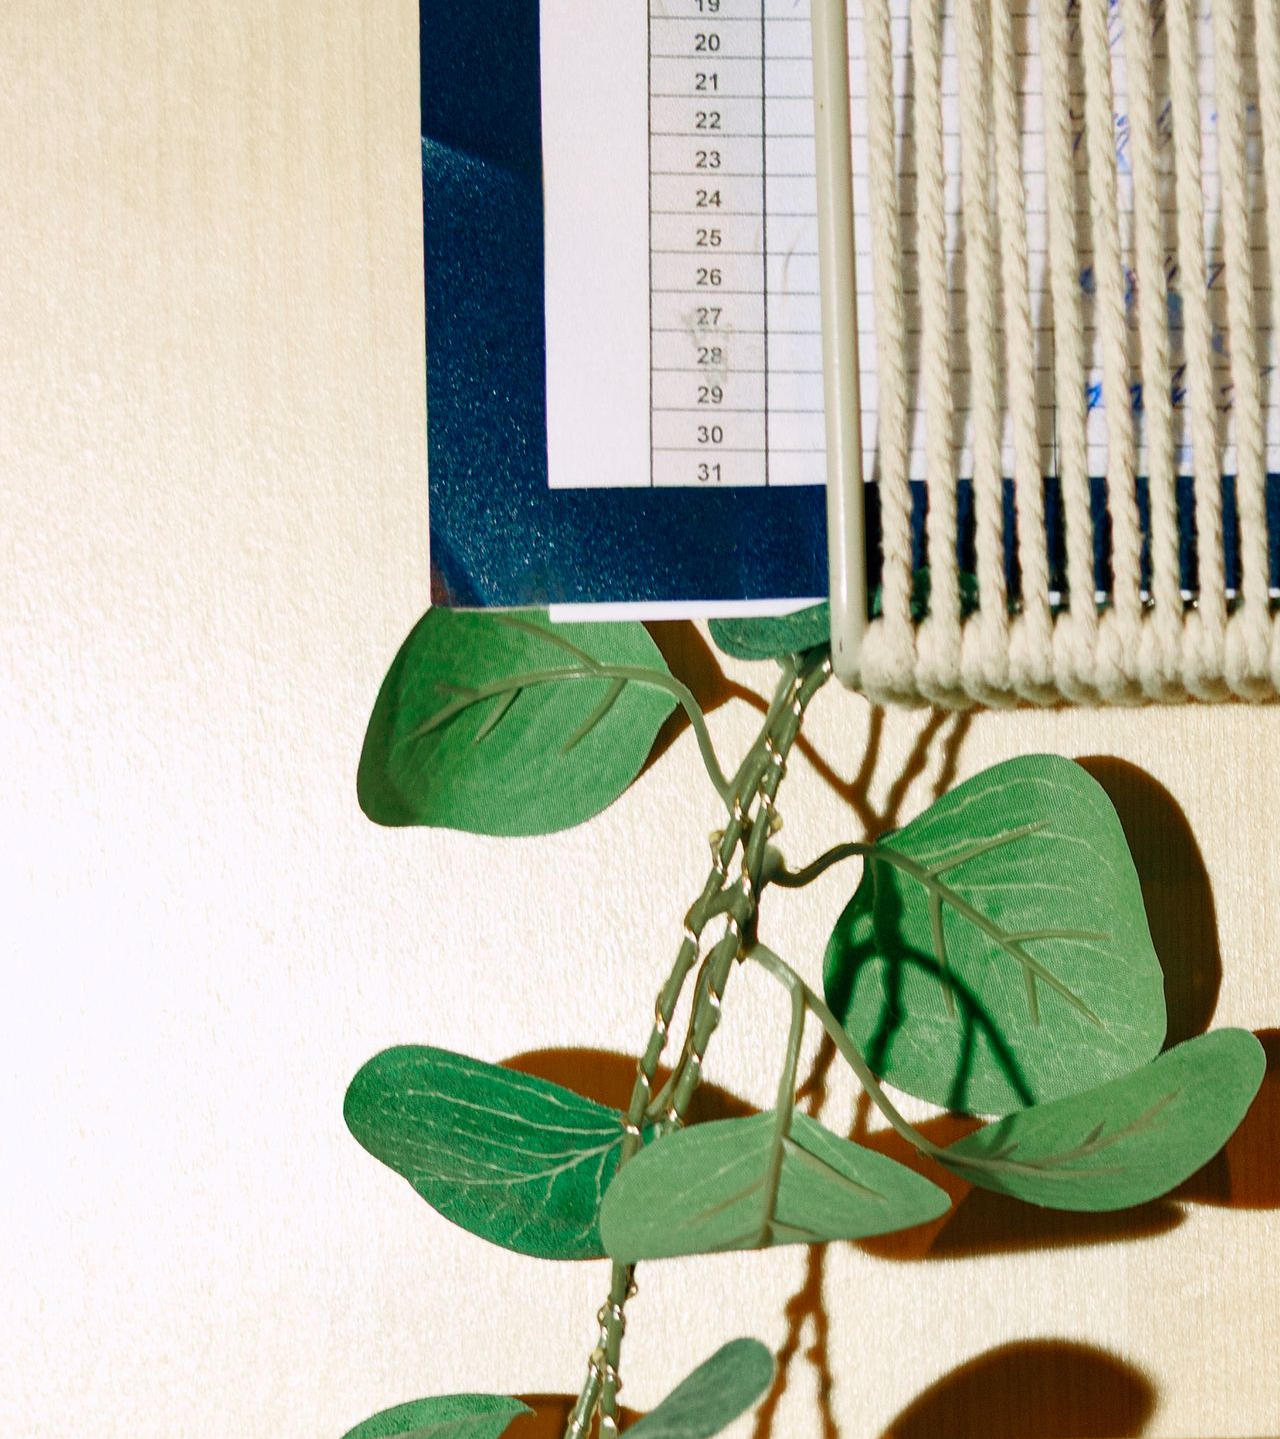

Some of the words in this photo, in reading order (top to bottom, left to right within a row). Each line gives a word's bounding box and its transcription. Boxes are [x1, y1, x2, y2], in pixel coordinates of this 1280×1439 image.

[693, 32, 720, 53] 20
[694, 71, 719, 92] 21
[694, 110, 721, 131] 22
[694, 149, 721, 170] 23
[695, 188, 722, 209] 24
[695, 227, 722, 248] 25
[695, 266, 722, 287] 26
[696, 305, 723, 326] 27
[696, 344, 723, 365] 28
[696, 384, 723, 405] 29
[697, 423, 724, 444] 30
[697, 462, 722, 483] 31
